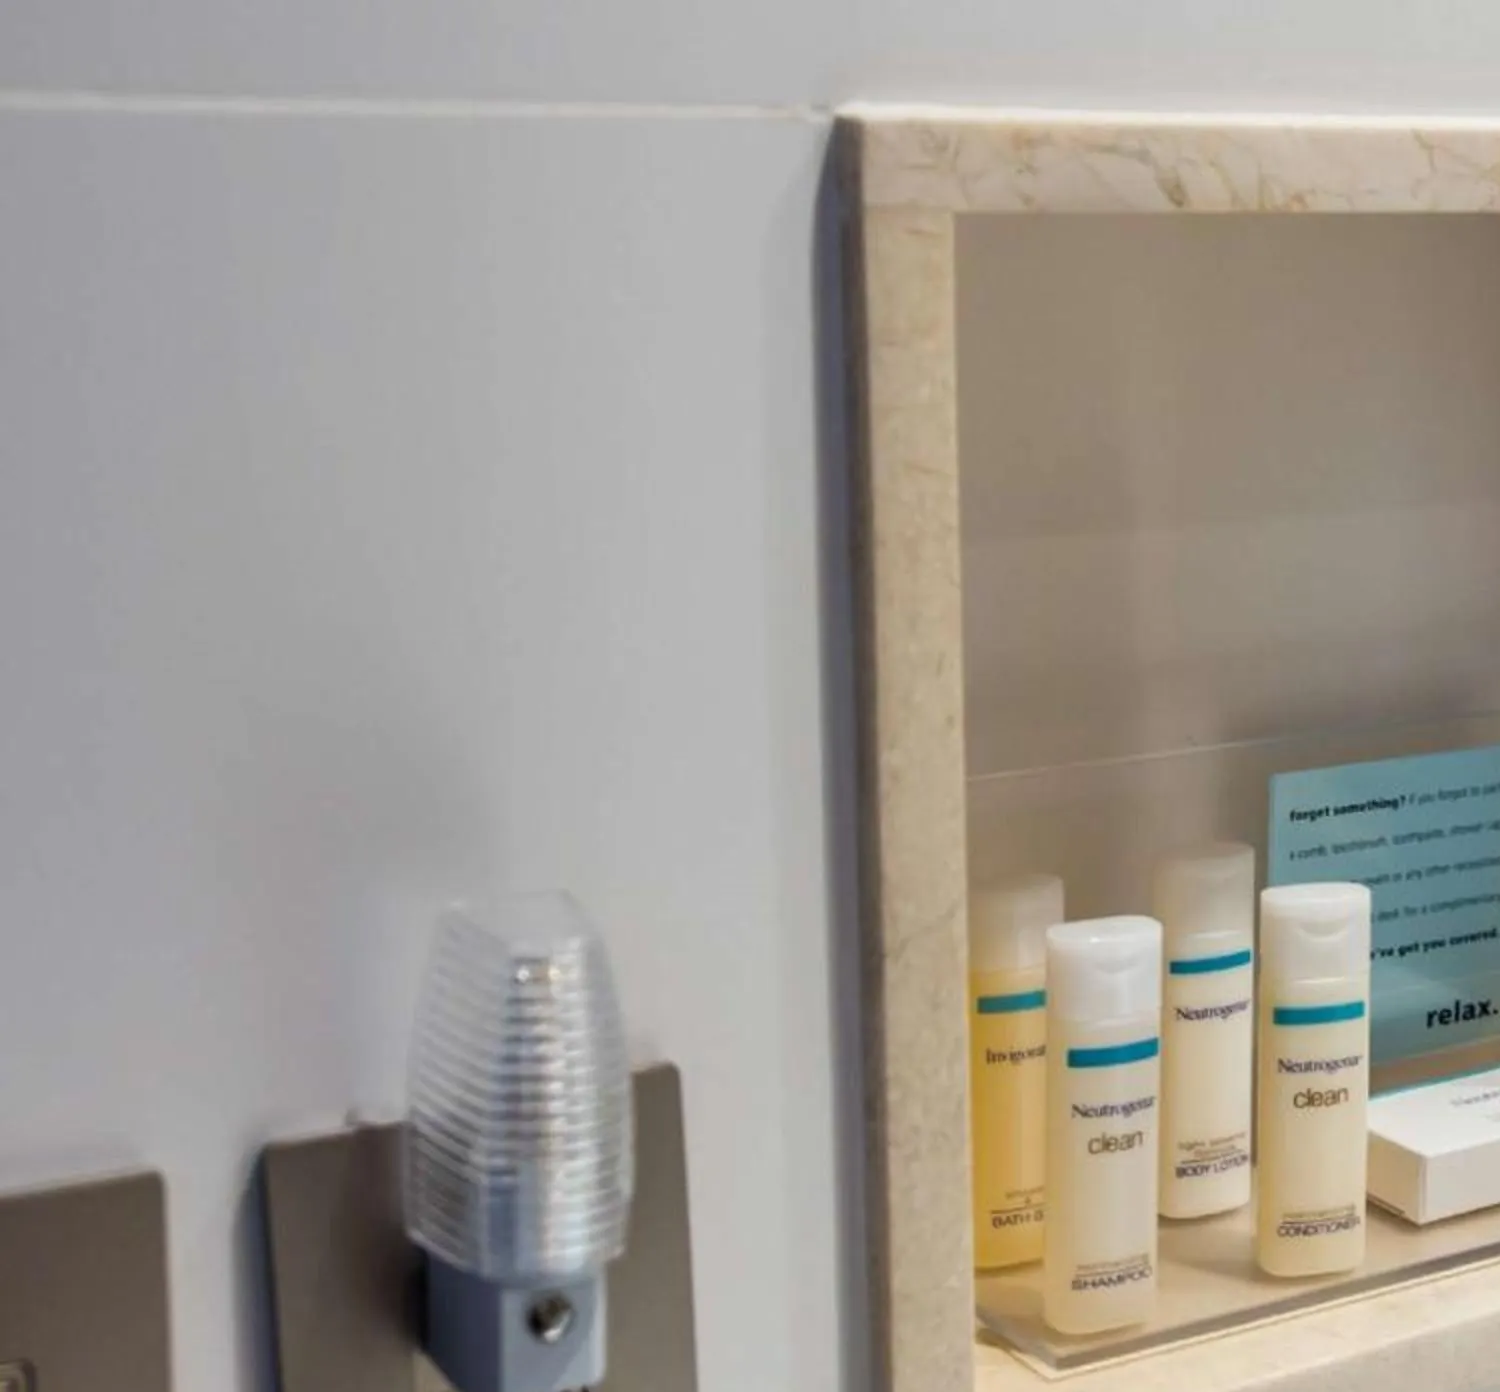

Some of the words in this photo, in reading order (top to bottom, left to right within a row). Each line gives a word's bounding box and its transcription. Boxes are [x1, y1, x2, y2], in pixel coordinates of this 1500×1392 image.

[1289, 806, 1331, 823] forget
[1333, 794, 1406, 816] something?
[1422, 938, 1447, 954] you
[1426, 999, 1499, 1030] relax.
[1293, 1087, 1349, 1109] clean
[1087, 1131, 1144, 1154] clean
